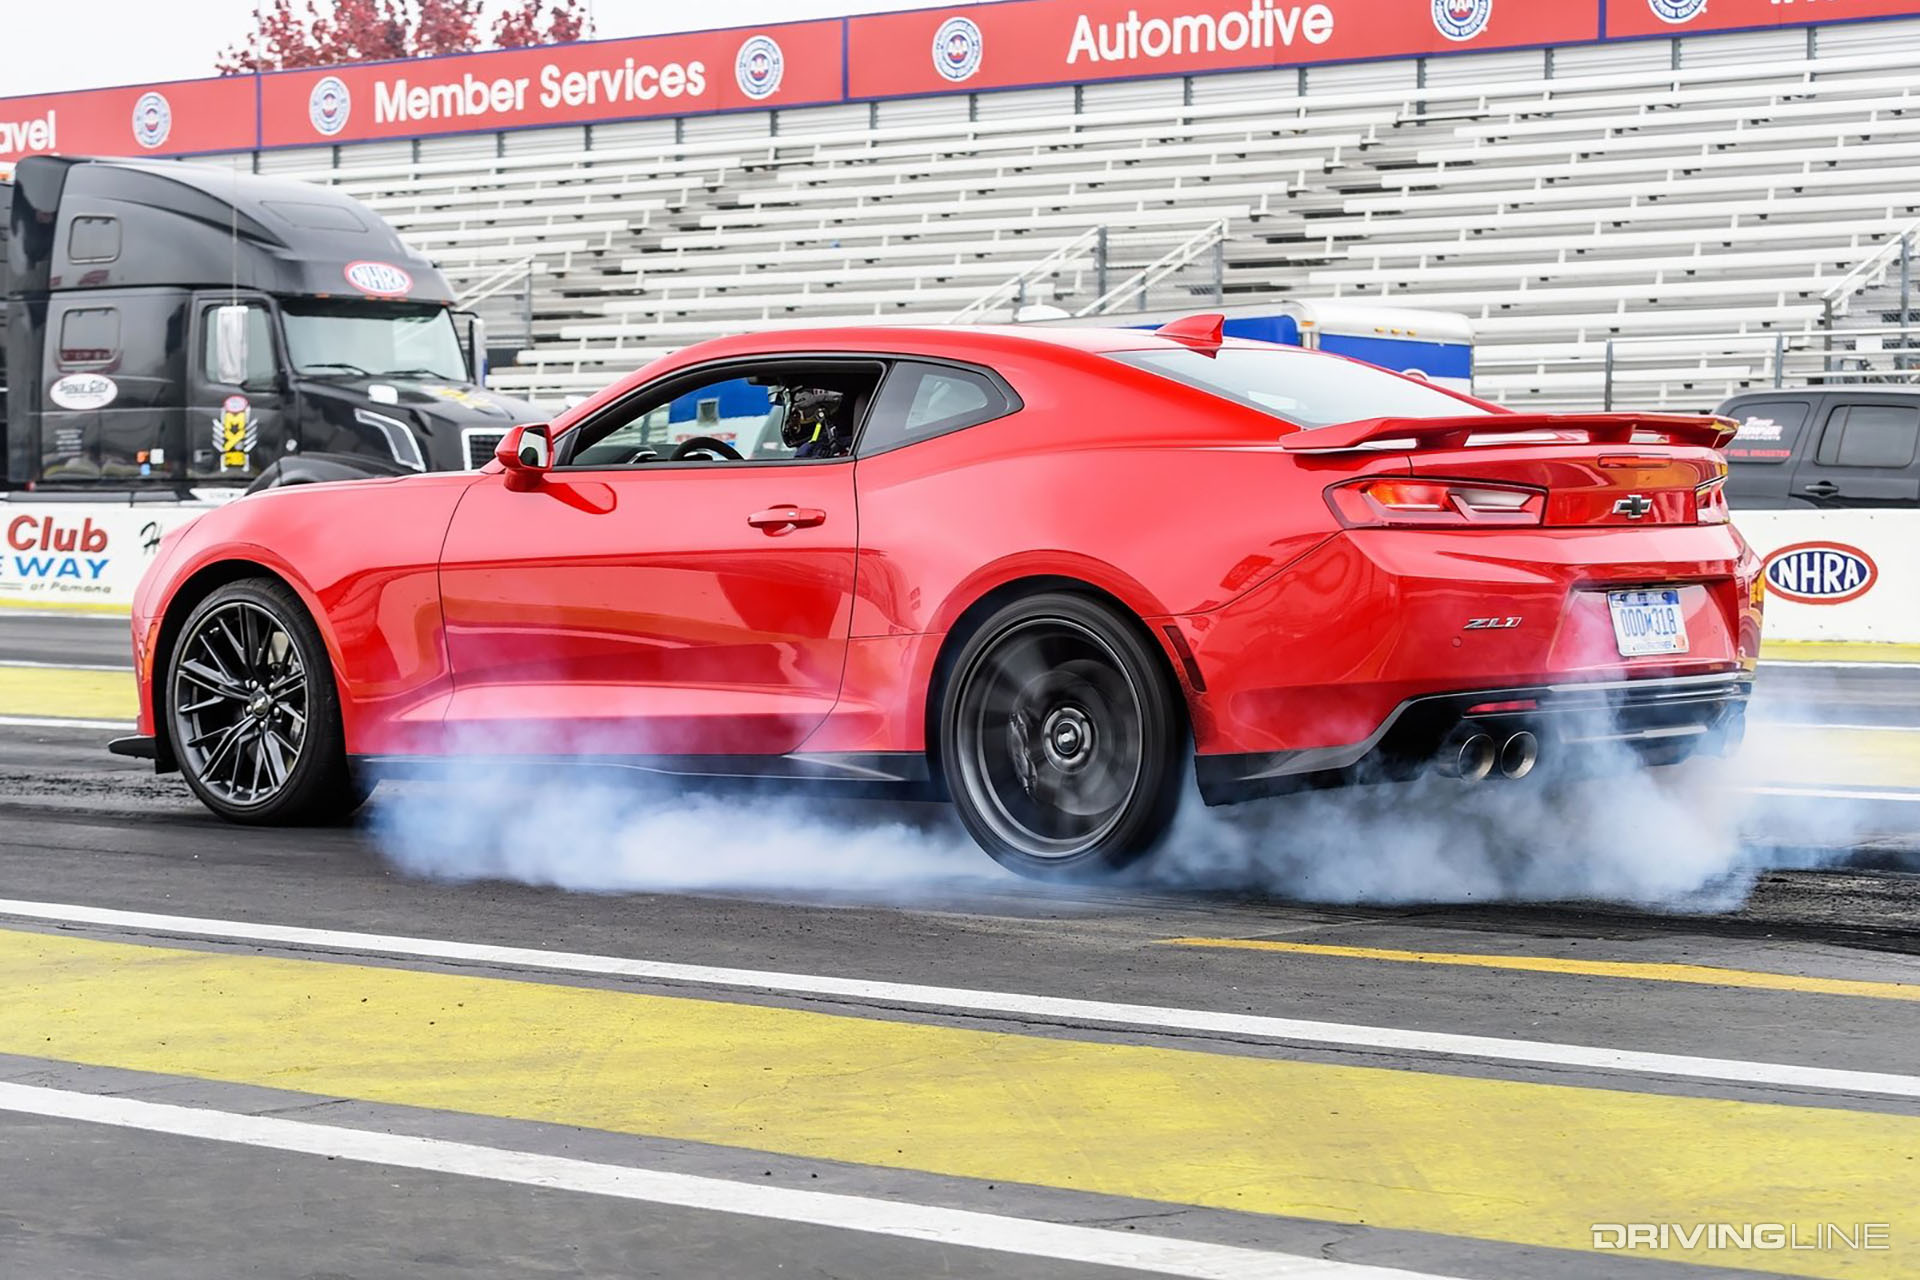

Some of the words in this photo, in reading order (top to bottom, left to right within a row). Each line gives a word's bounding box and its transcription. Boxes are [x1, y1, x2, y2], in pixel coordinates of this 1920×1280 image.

[1066, 2, 1335, 64] Automotive
[374, 73, 529, 124] Member
[539, 58, 706, 109] Services
[7, 514, 109, 553] Club
[1777, 551, 1861, 595] NHRA
[1463, 616, 1523, 630] ZL1
